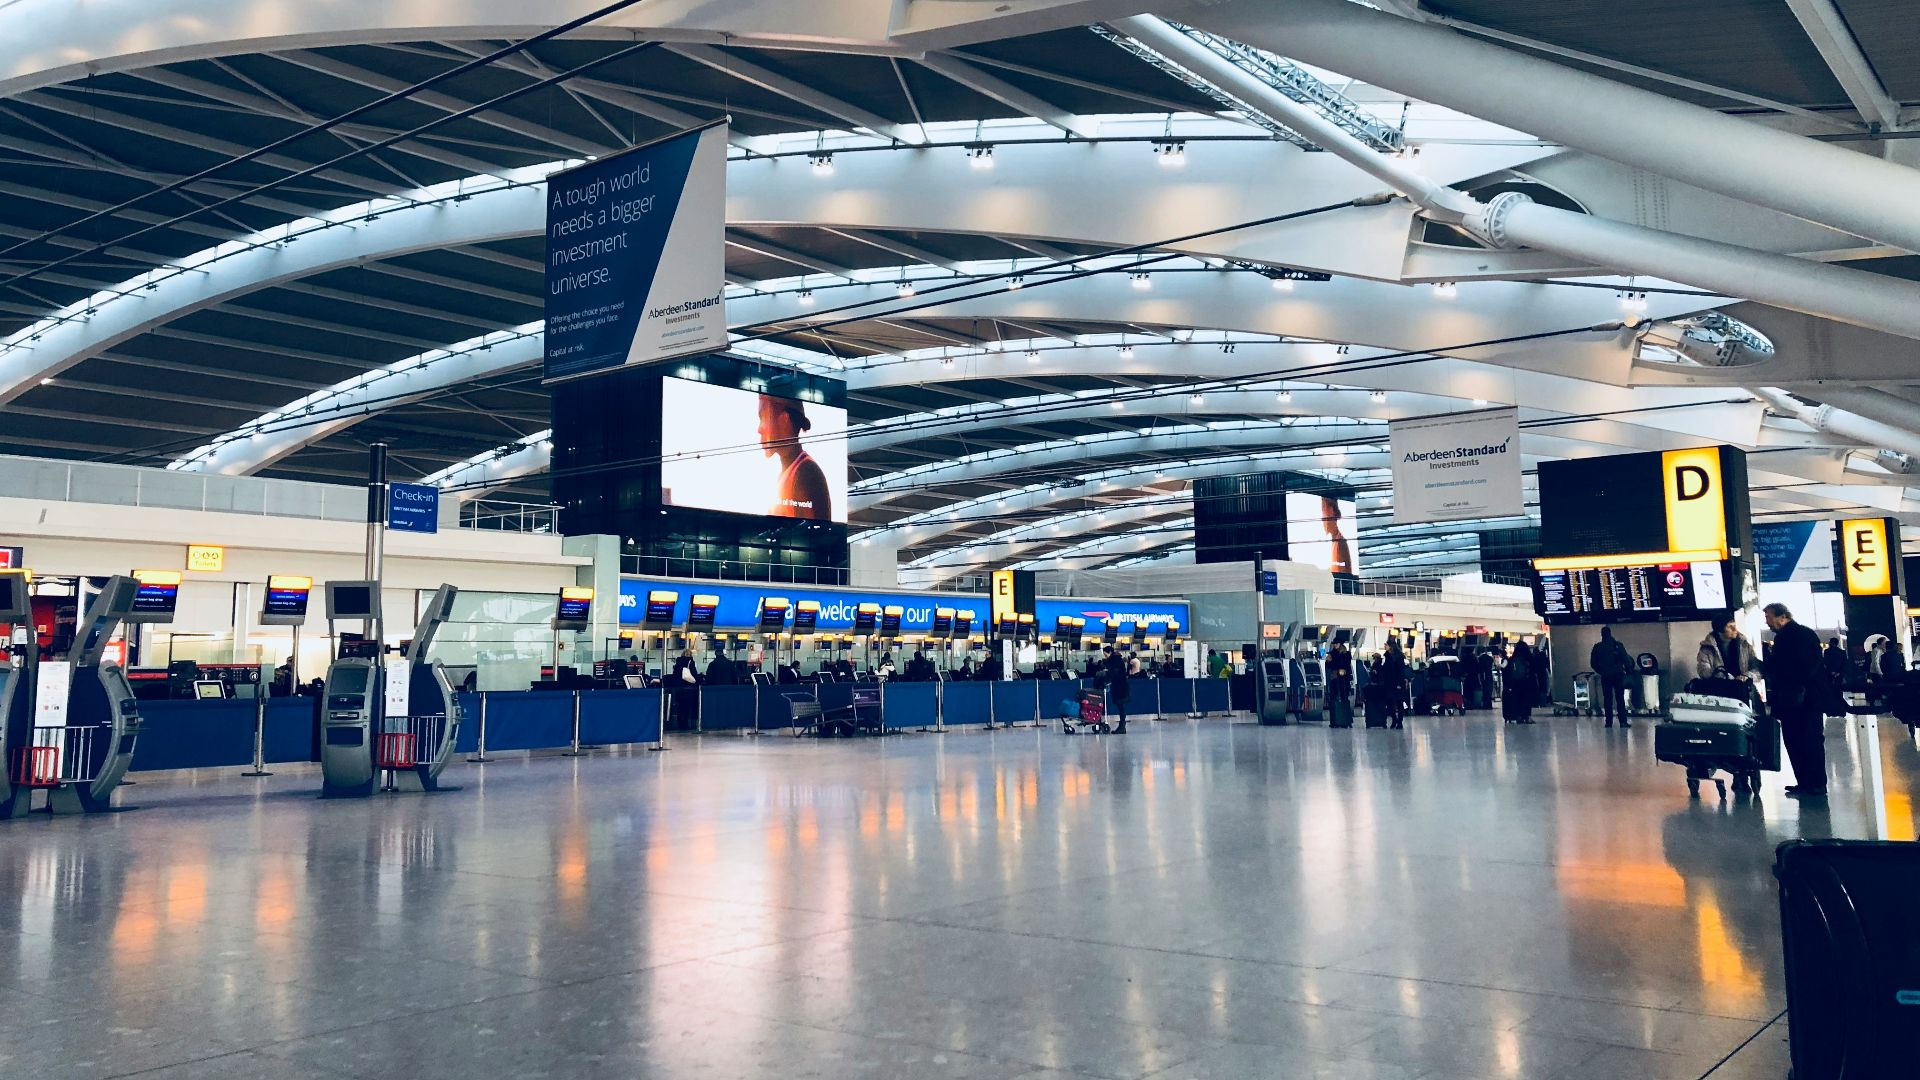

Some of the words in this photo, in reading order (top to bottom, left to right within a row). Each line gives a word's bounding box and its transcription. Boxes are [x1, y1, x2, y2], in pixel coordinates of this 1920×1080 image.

[553, 190, 563, 210] A
[566, 177, 605, 205] tough
[610, 161, 650, 192] world
[553, 210, 594, 238] needs
[598, 209, 606, 225] a
[611, 194, 656, 224] bigger
[552, 230, 628, 267] investment
[551, 267, 612, 295] universe.
[550, 312, 571, 325] Offering
[571, 311, 581, 320] the
[581, 308, 598, 318] choice
[599, 305, 610, 315] you
[610, 300, 625, 310] need
[648, 295, 720, 319] AberdeenStandard
[550, 326, 558, 335] for
[558, 323, 568, 333] the
[568, 318, 595, 331] challenges
[595, 317, 606, 327] you
[665, 312, 700, 325] Investments
[549, 346, 567, 358] Capital
[567, 345, 574, 353] at
[1403, 443, 1507, 463] AberdeenStandard
[1429, 458, 1480, 471] Investments
[1675, 465, 1710, 501] D
[394, 488, 434, 503] Check-in
[798, 500, 813, 508] world
[1856, 529, 1875, 554] E
[998, 578, 1008, 596] E
[906, 607, 932, 623] our
